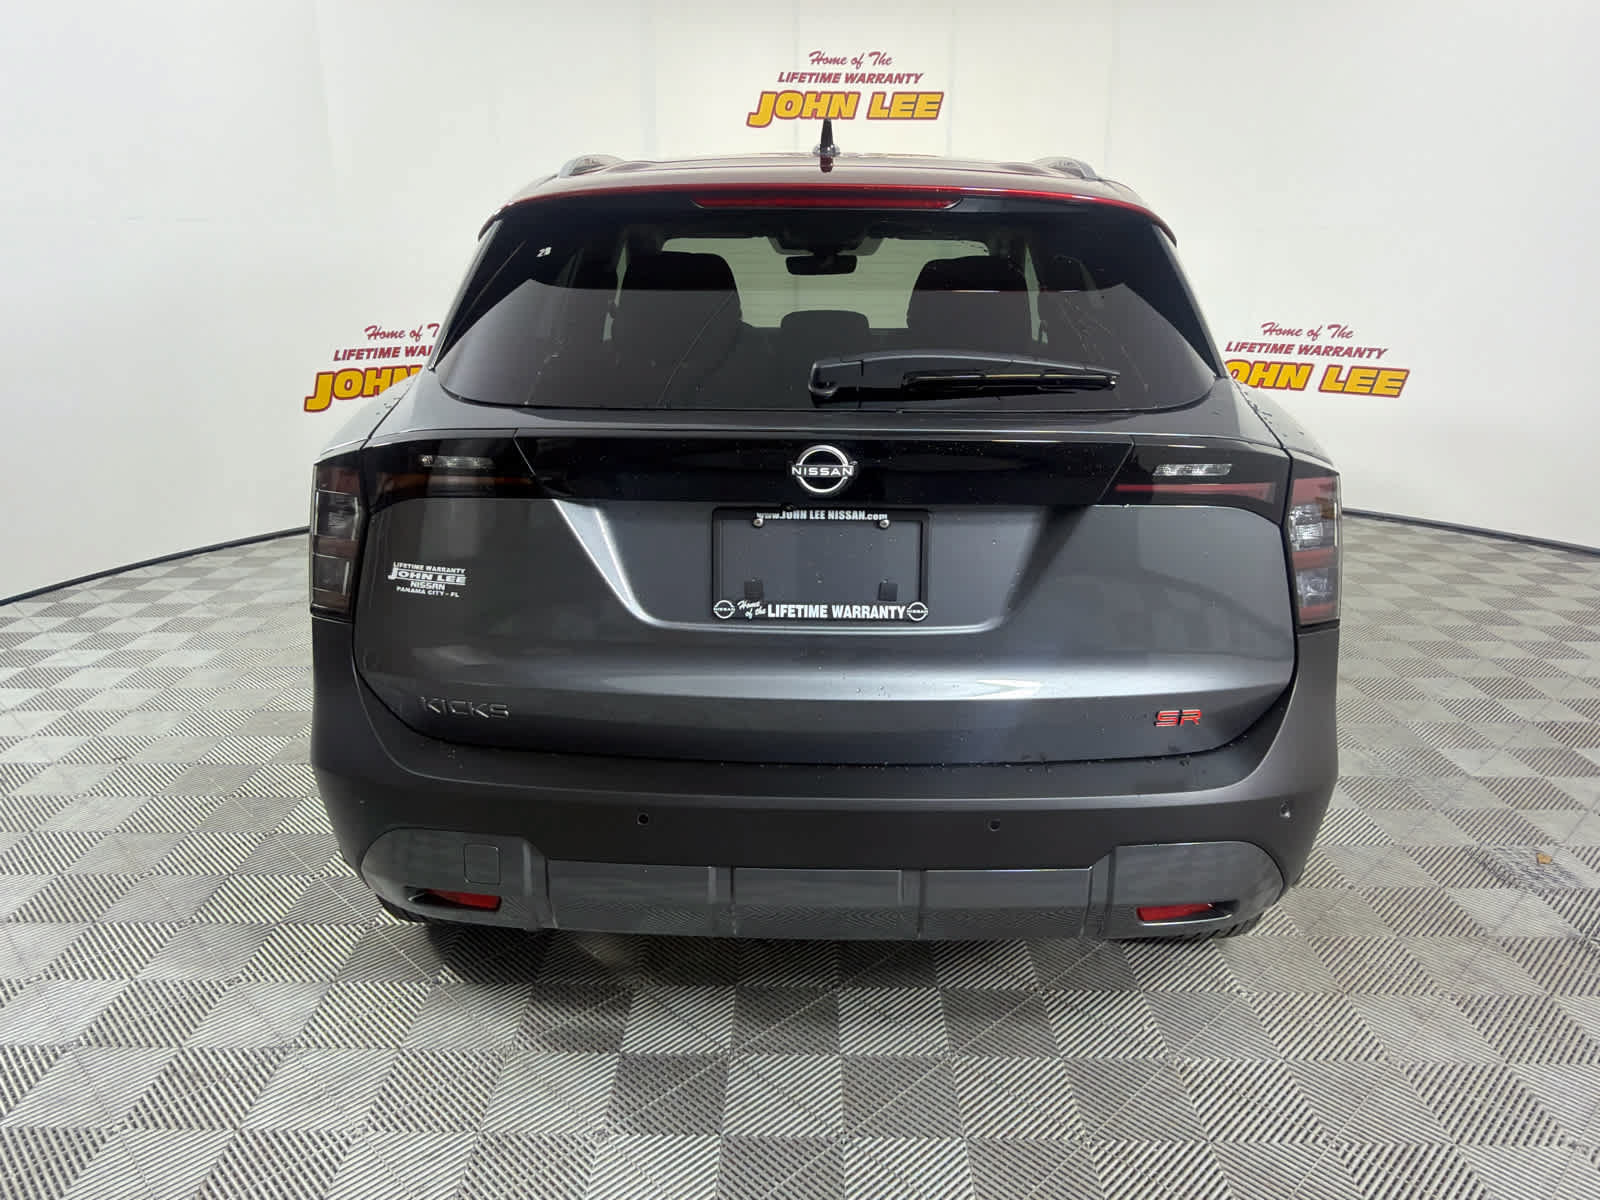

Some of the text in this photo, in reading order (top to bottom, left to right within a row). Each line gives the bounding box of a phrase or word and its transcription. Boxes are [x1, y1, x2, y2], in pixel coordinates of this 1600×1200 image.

[809, 50, 893, 69] Home of The
[777, 72, 924, 84] LIFETIME WARRANTY
[746, 90, 944, 128] JOHN LEE
[364, 325, 406, 340] Home
[409, 325, 423, 342] of
[1261, 321, 1353, 341] Home of The
[333, 347, 401, 361] LIFETIME
[1225, 341, 1388, 359] LIFETIME WARRANTY
[1225, 359, 1410, 398] OHN LEE
[791, 465, 854, 477] NISSAN
[809, 511, 826, 520] LEE
[393, 561, 466, 574] LIFETIME WARRANTY
[387, 567, 467, 586] JOHN LEE
[396, 586, 426, 595] PANAMA
[410, 581, 446, 591] NISSAN
[737, 600, 761, 611] Home
[767, 604, 906, 619] LIFETIME WARRANTY
[420, 696, 510, 719] KICKS
[1154, 708, 1202, 727] SR
